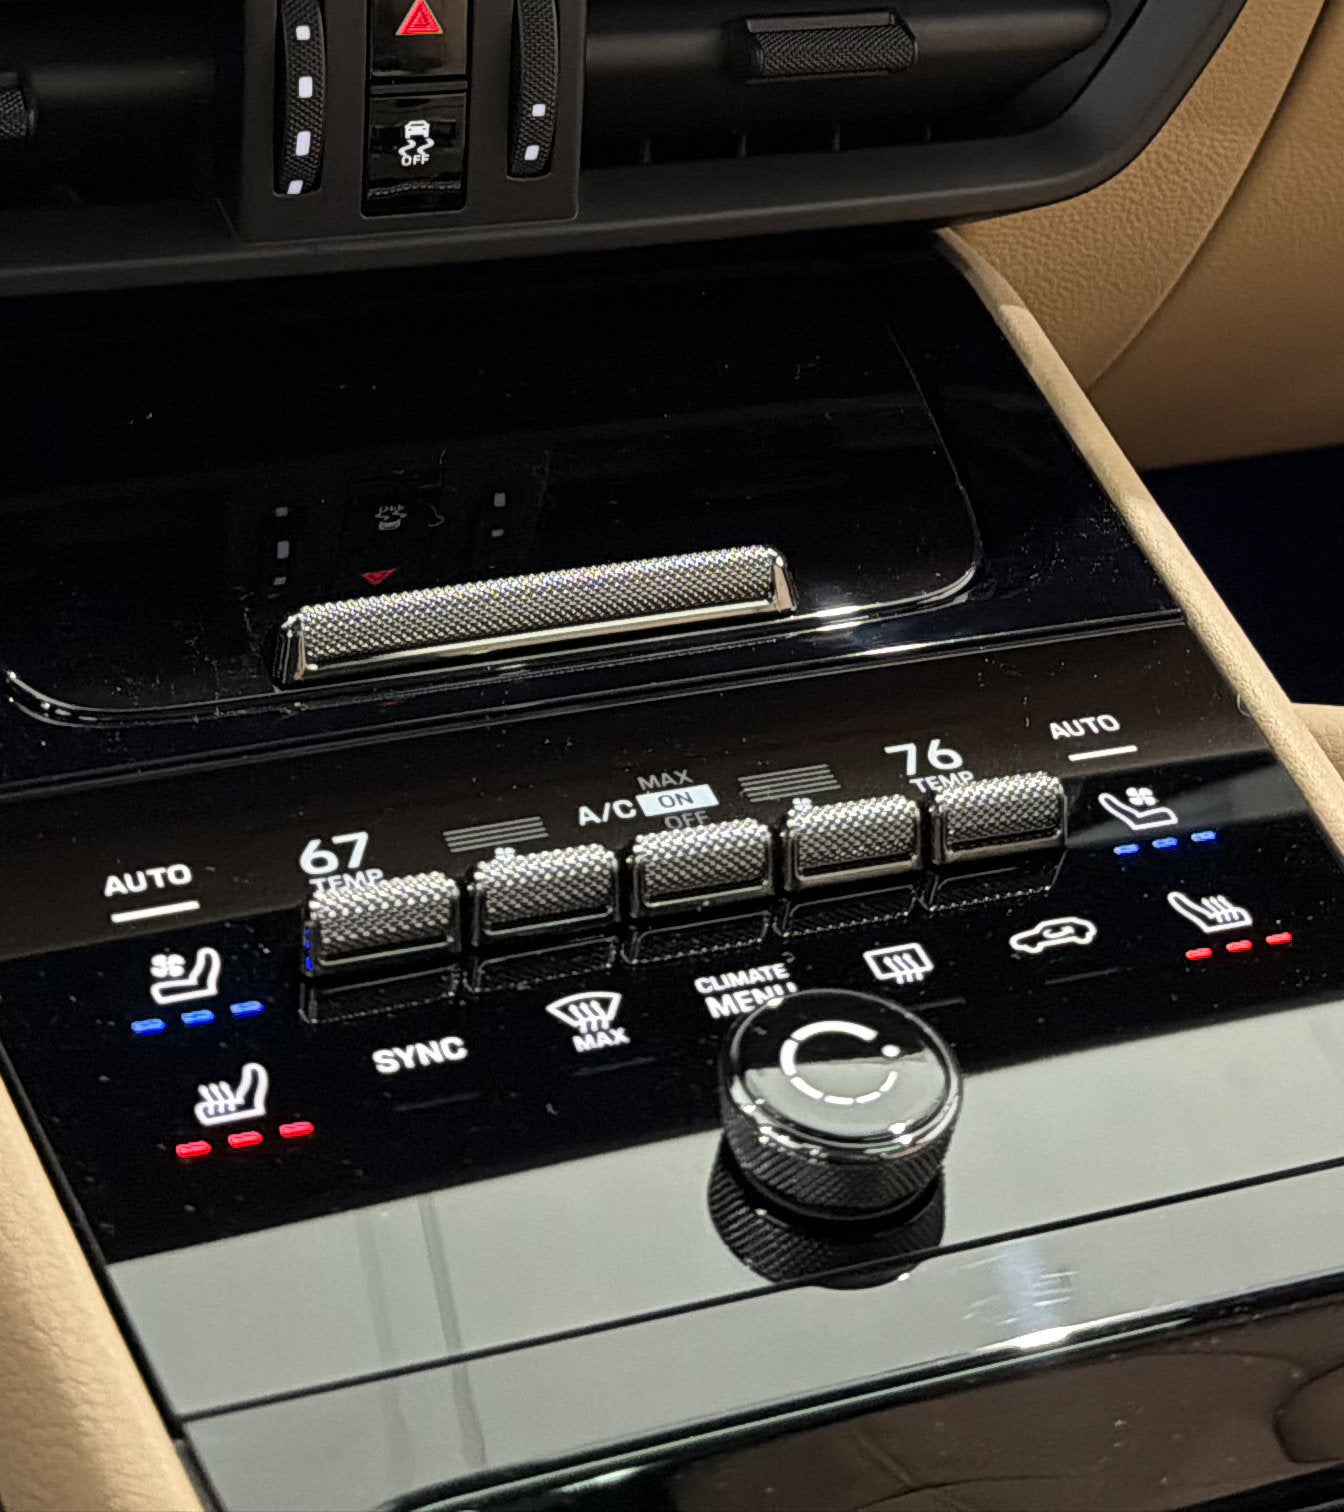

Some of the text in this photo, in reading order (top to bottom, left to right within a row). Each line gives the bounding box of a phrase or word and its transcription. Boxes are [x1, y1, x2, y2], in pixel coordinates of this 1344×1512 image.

[401, 153, 430, 167] OFF
[1049, 714, 1121, 740] AUTO
[884, 738, 963, 776] 76
[637, 769, 694, 791] MAX
[908, 770, 975, 794] TEMP
[578, 791, 694, 826] A/C ON
[664, 810, 709, 830] OFF
[299, 831, 369, 875] 67
[103, 863, 192, 897] AUTO
[309, 868, 384, 891] TEMP
[694, 963, 790, 994] CLIMATE
[572, 1027, 630, 1053] MAX
[371, 1036, 468, 1074] SYNC
